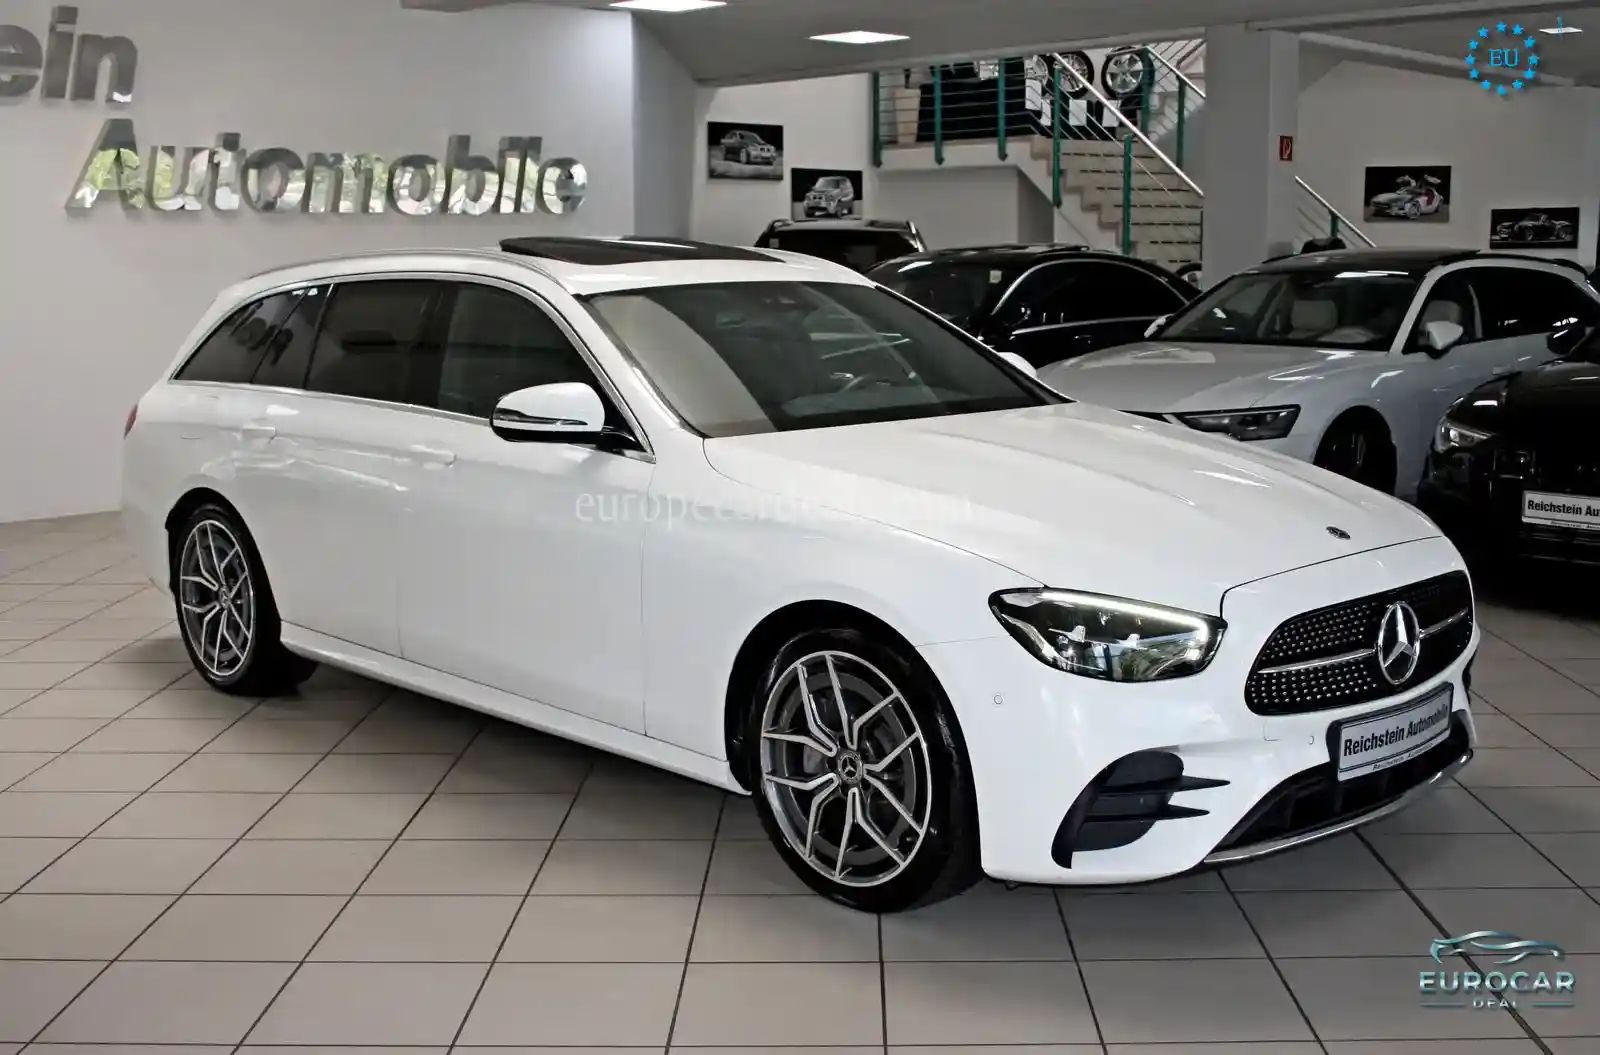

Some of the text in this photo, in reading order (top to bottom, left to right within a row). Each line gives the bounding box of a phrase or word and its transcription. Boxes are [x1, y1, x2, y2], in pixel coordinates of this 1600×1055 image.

[66, 118, 588, 215] Automobile
[1527, 499, 1582, 515] Reichstein
[1343, 725, 1405, 757] Reichstein
